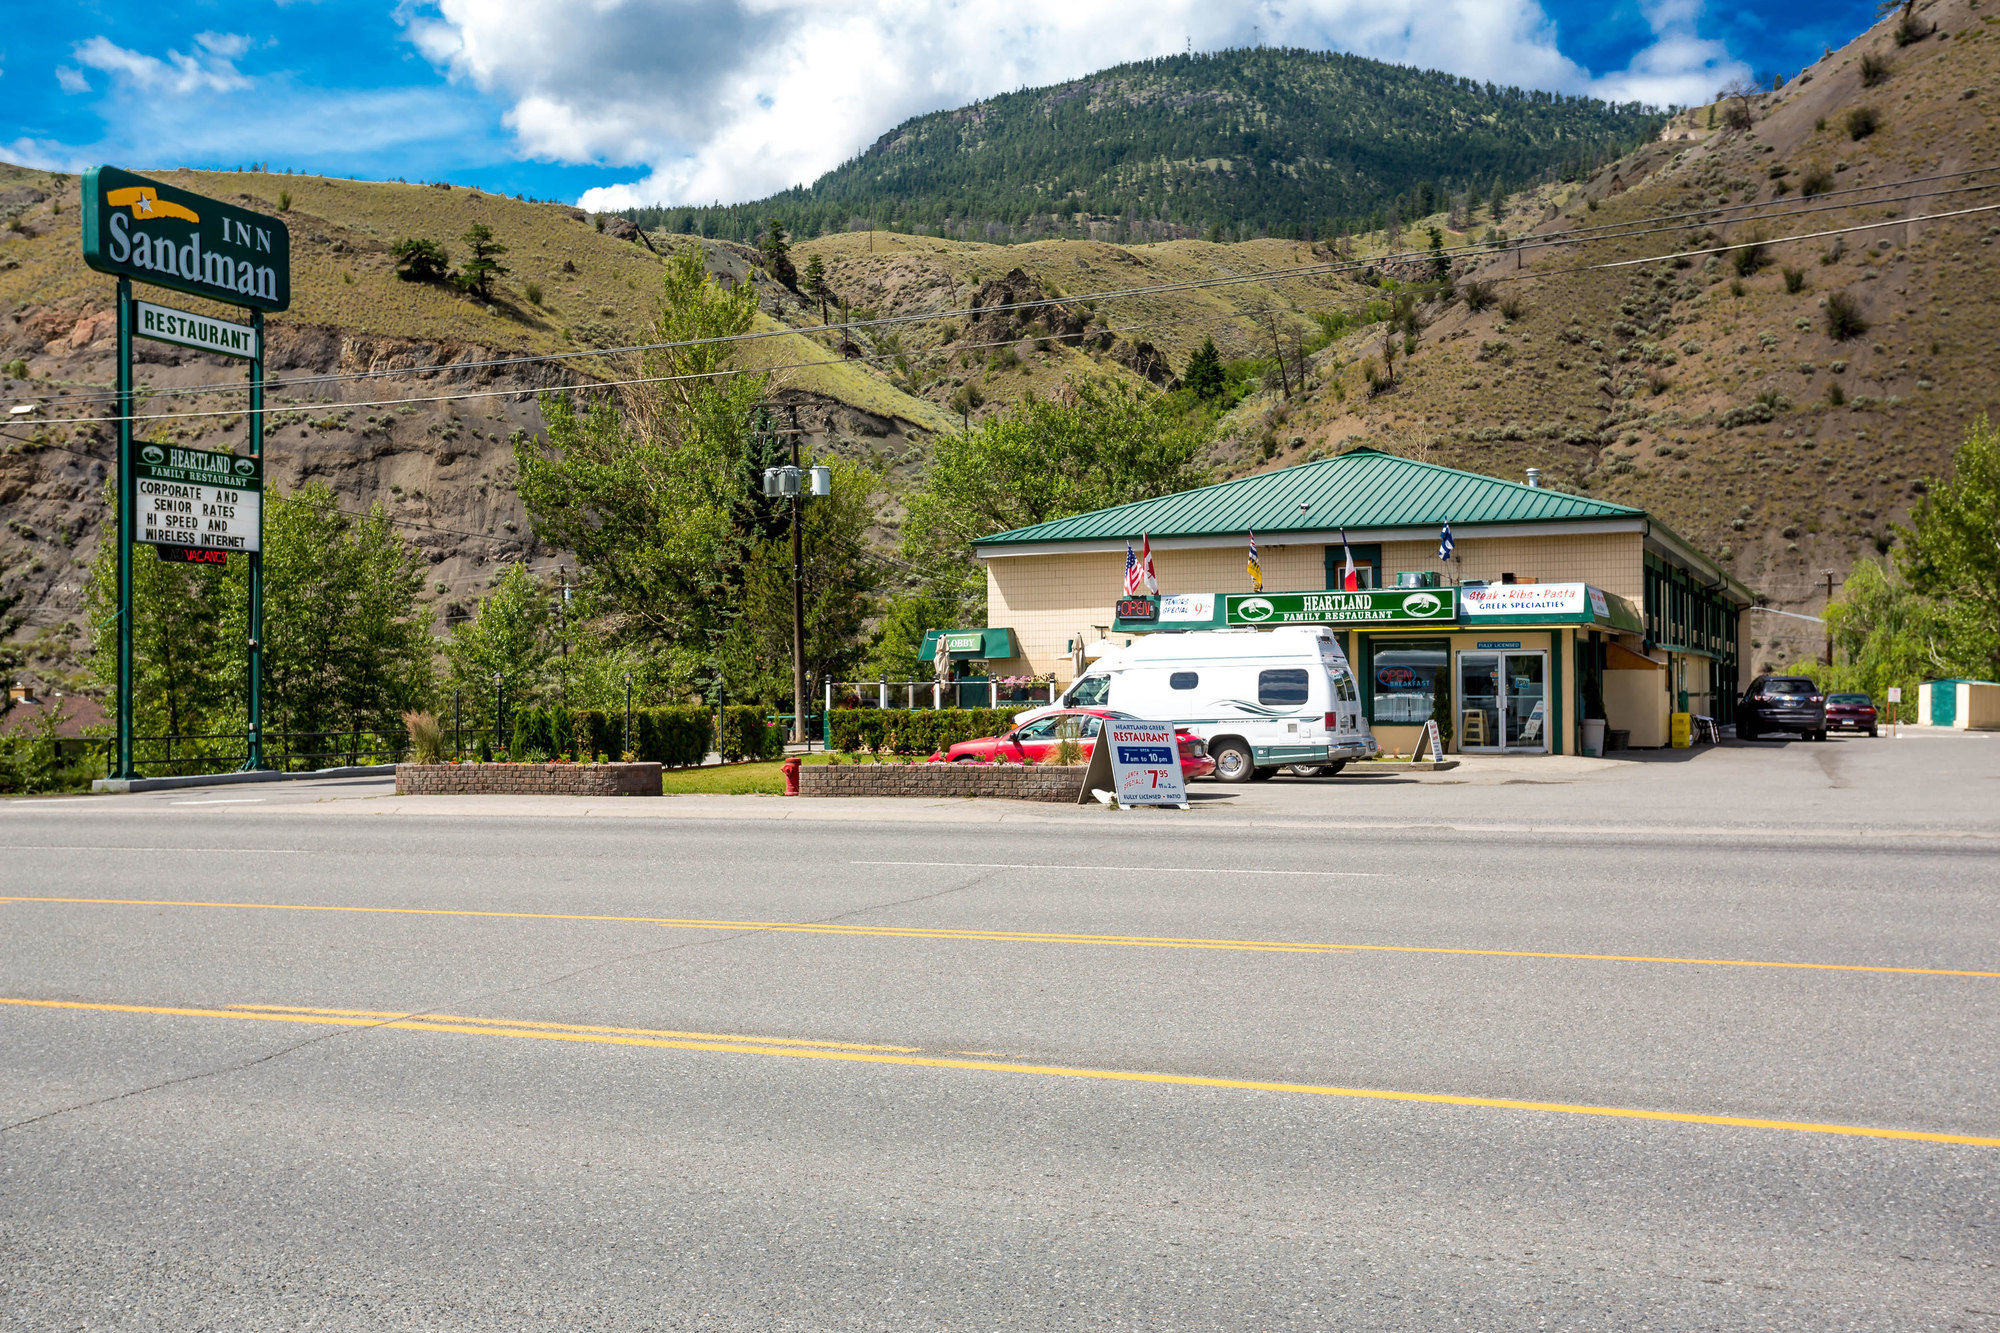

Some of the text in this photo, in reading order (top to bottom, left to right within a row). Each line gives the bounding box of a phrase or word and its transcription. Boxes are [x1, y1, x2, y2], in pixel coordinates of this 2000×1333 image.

[222, 216, 272, 254] INN
[109, 212, 278, 301] Sandman
[144, 310, 251, 351] RESTAURANT
[170, 448, 230, 473] HEARTLAND
[151, 467, 248, 487] FAMILY RESTAURANT
[140, 481, 239, 503] CORPORATE AND
[154, 498, 235, 518] SENIOR RATES
[146, 513, 228, 532] HI SPEED AND
[145, 528, 246, 548] WIRELESS INTERNET
[184, 549, 228, 563] VACANCY
[1303, 594, 1372, 611] HEARTLAND
[1469, 588, 1576, 601] Steak Ribs Pasta
[1120, 601, 1150, 616] OPEN
[1479, 602, 1507, 610] GREEK
[1283, 611, 1393, 622] FAMILY RESTAURANT
[1380, 669, 1413, 682] OPEN
[1113, 731, 1169, 742] RESTAURANT
[1124, 752, 1130, 762] 7
[1149, 753, 1158, 762] 10
